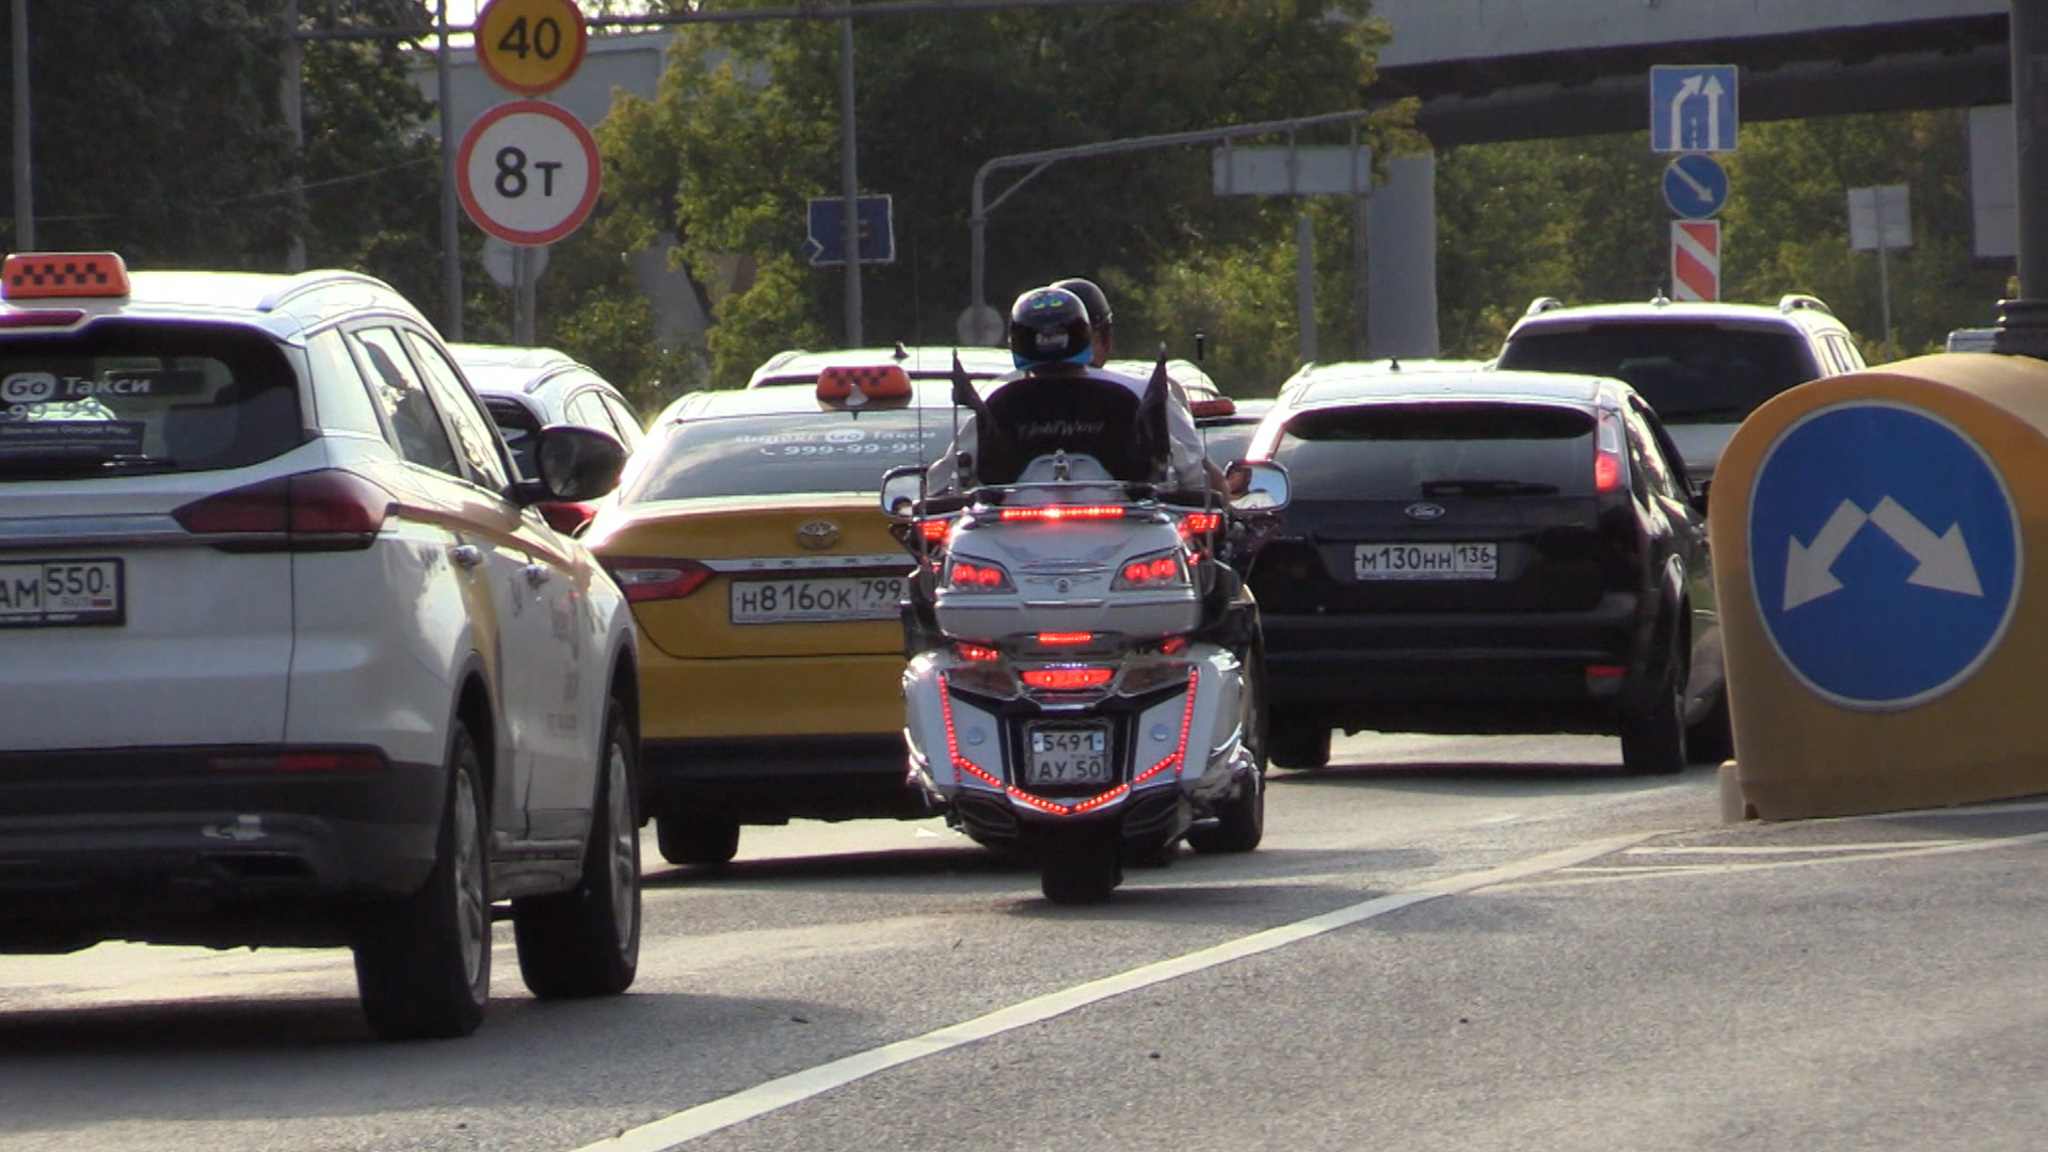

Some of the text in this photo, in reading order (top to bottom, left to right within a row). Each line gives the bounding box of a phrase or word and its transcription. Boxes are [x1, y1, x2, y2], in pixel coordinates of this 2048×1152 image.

[498, 16, 562, 60] 40
[62, 376, 151, 395] Такси
[1361, 547, 1490, 570] М130НН 136
[46, 566, 104, 595] 550
[742, 580, 901, 612] Н816ОК 799
[1043, 734, 1094, 751] 5491
[1076, 760, 1101, 778] 50
